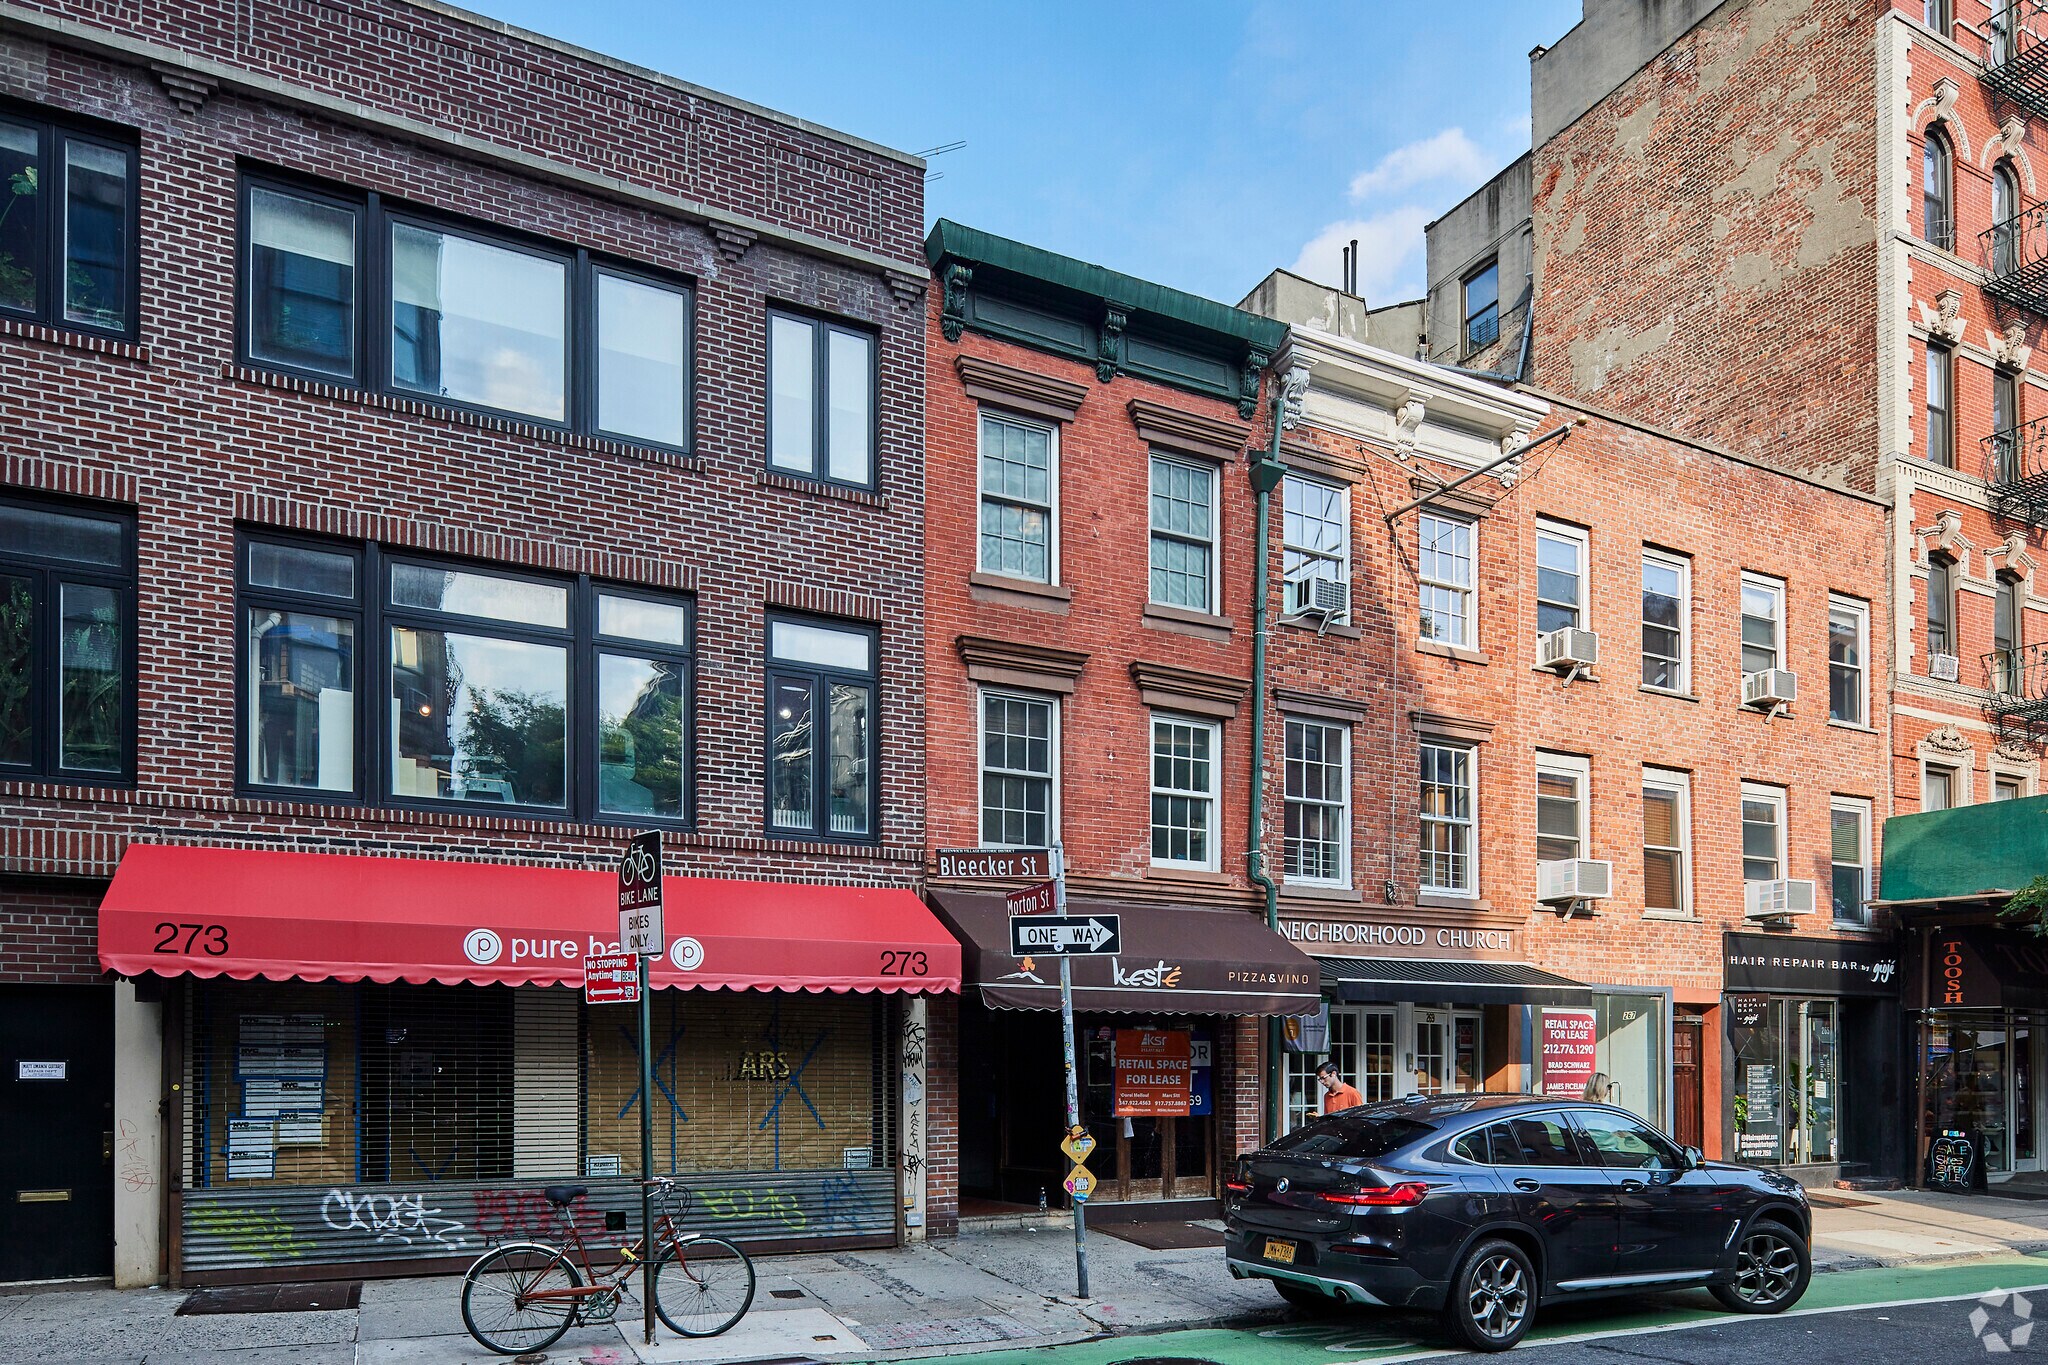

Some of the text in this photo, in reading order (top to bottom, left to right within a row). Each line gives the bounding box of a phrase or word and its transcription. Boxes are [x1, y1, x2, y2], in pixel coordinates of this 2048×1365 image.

[940, 855, 1037, 876] Bleecker St
[620, 886, 659, 906] BIKE LANE
[1007, 895, 1037, 917] Morton
[1040, 889, 1050, 909] St
[628, 914, 650, 931] BIKES
[153, 922, 229, 956] 273
[630, 935, 648, 949] ONLY
[1028, 928, 1103, 943] ONE WAY
[1277, 920, 1510, 950] NEIGHBORHOOD CHURCH
[511, 938, 578, 963] pure
[587, 958, 628, 969] NO STOPPING
[880, 950, 928, 976] 273
[1729, 955, 1766, 966] HAIR
[1772, 957, 1825, 969] REPAIR
[1831, 960, 1858, 970] BAR
[1860, 964, 1870, 972] by
[588, 970, 613, 982] Anytime
[1943, 941, 1964, 1004] TOOSH
[1623, 1011, 1636, 1020] 267
[1545, 1019, 1594, 1029] RETAIL SPACE
[1550, 1030, 1588, 1040] FOR LEASE
[1543, 1044, 1594, 1054] 212.776.1290
[1119, 1059, 1188, 1070] RETAIL SPACE
[1126, 1074, 1181, 1084] FOR LEASE
